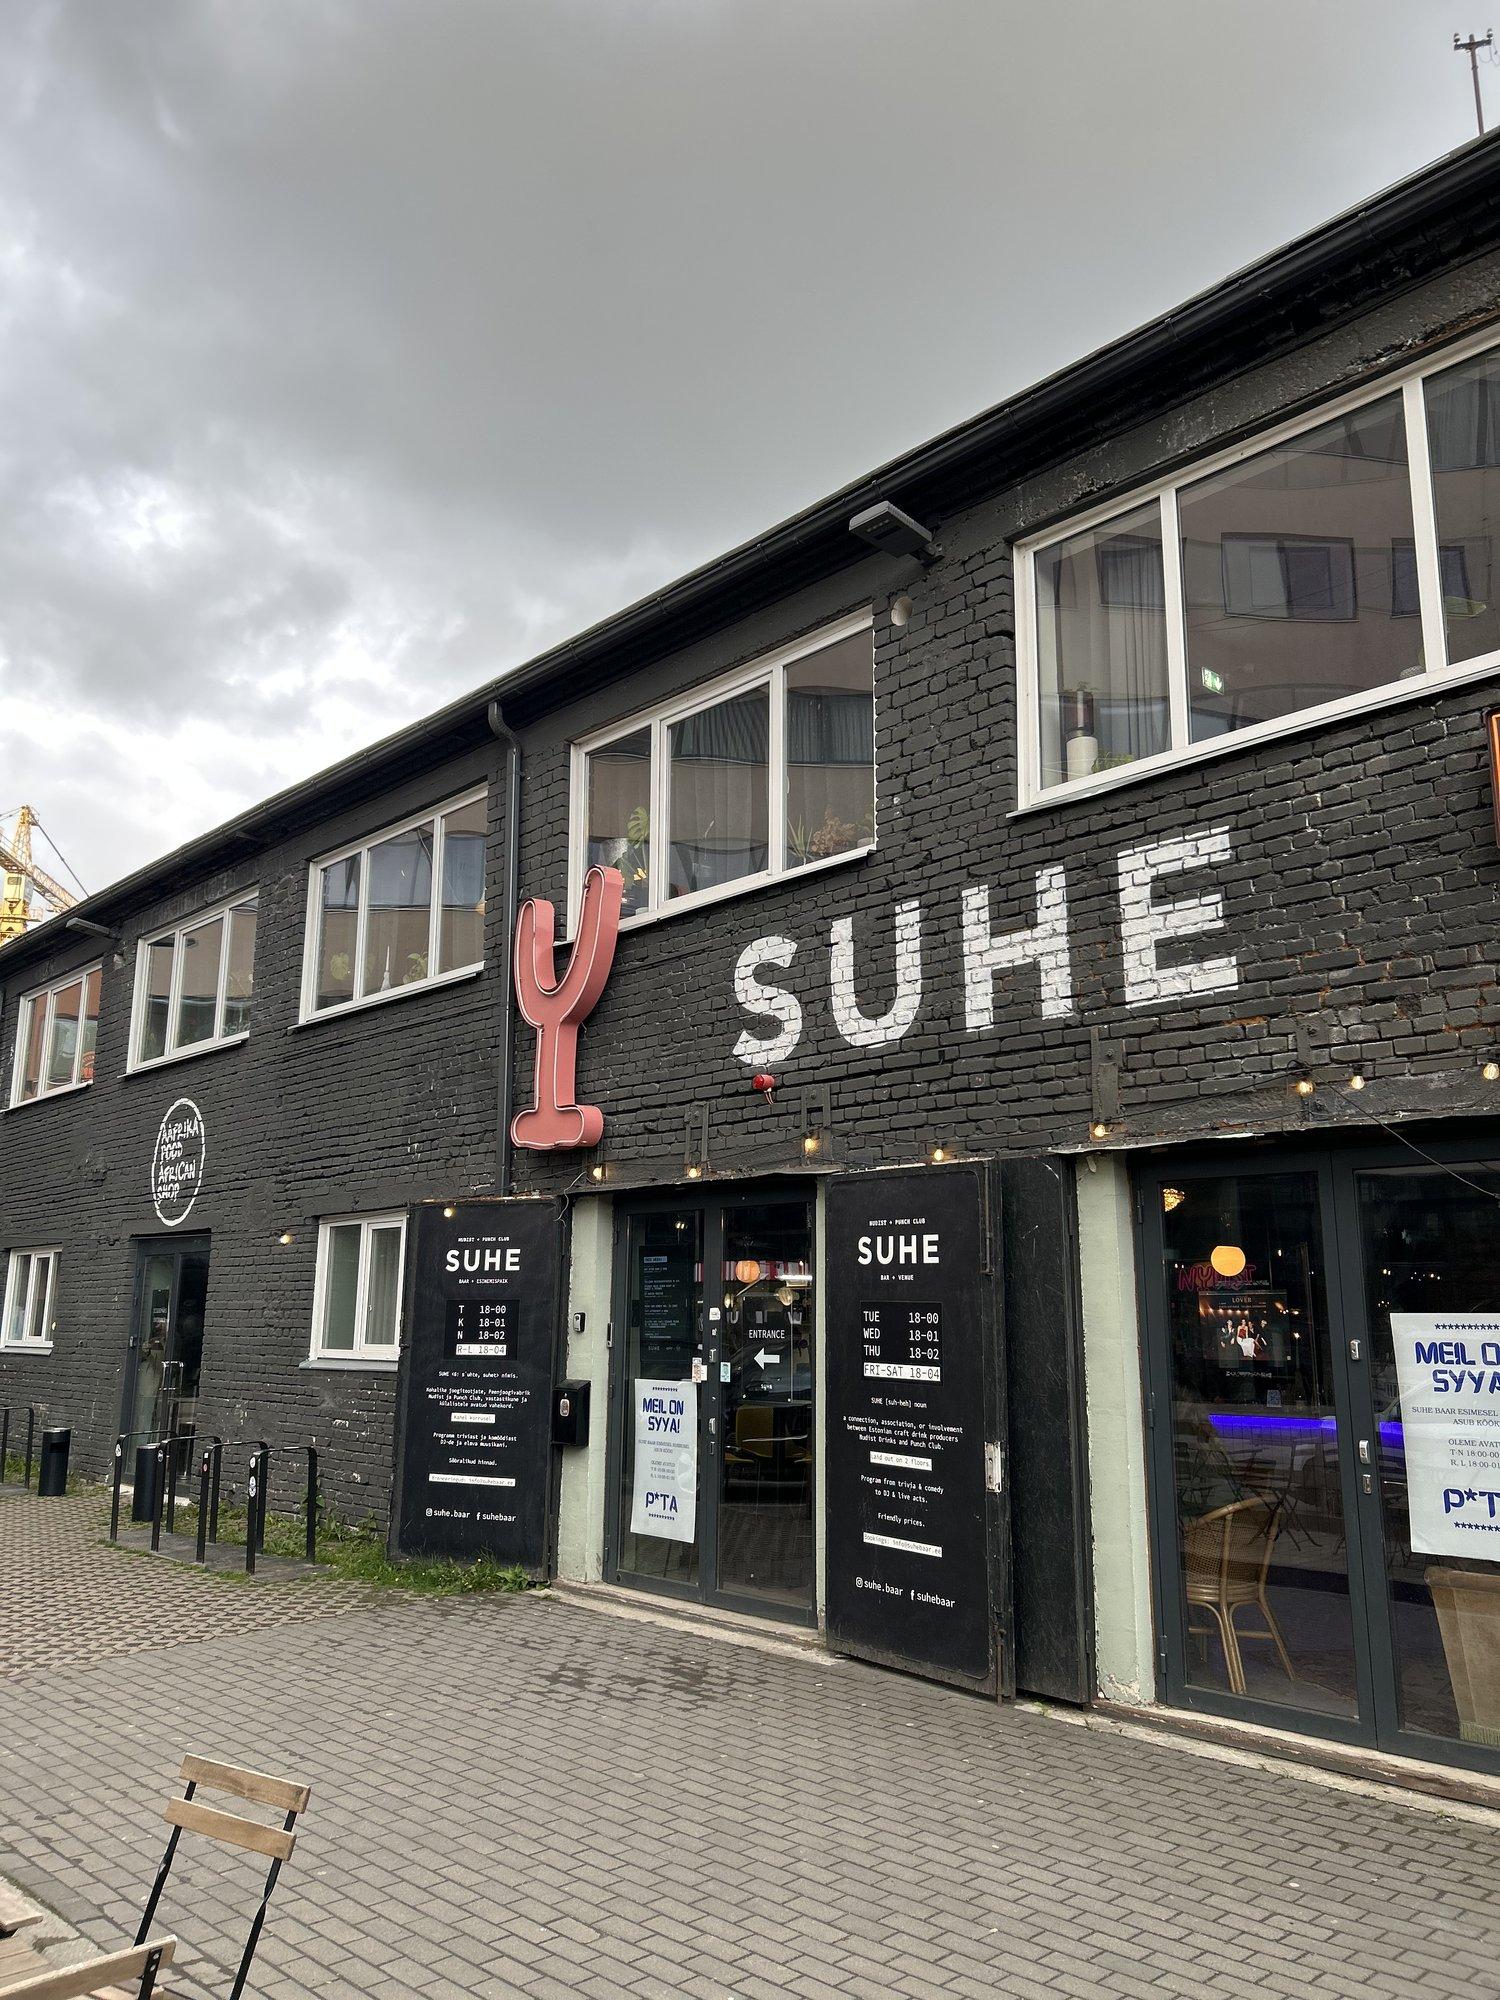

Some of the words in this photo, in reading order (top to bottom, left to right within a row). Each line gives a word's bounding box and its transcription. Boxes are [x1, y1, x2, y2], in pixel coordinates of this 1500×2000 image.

[732, 825, 1239, 1067] SUHE
[160, 1142, 183, 1164] FOOD
[158, 1159, 196, 1184] AFRICAN
[857, 1233, 940, 1265] SUHE
[445, 1248, 521, 1272] SUHE
[458, 1305, 465, 1314] T
[479, 1305, 507, 1314] 18-00
[458, 1318, 464, 1327] K
[478, 1318, 506, 1327] 18-01
[863, 1311, 881, 1322] TUE
[908, 1312, 940, 1324] 18-00
[457, 1331, 463, 1340] N
[478, 1331, 506, 1340] 18-02
[748, 1329, 786, 1339] ENTRANCE
[863, 1328, 881, 1339] WED
[909, 1330, 940, 1342] 18-01
[863, 1345, 881, 1357] THU
[909, 1347, 940, 1360] 18-02
[1415, 1341, 1476, 1366] MEIL
[864, 1364, 904, 1376] FRI-SAT
[909, 1367, 940, 1380] 18-04
[642, 1397, 667, 1416] MEIL
[669, 1399, 684, 1416] ON
[1435, 1407, 1456, 1415] BAAR
[1458, 1408, 1499, 1417] ESIMESEL
[648, 1416, 681, 1434] SYYA!
[1453, 1418, 1475, 1426] ASUB
[894, 1429, 910, 1437] craft
[898, 1438, 909, 1446] and
[1448, 1438, 1477, 1447] OLEME
[433, 1508, 471, 1518] suhe.baar
[482, 1512, 516, 1522] suhebaar
[864, 1580, 903, 1597] suhe.baar
[917, 1592, 955, 1608] suhebaar
